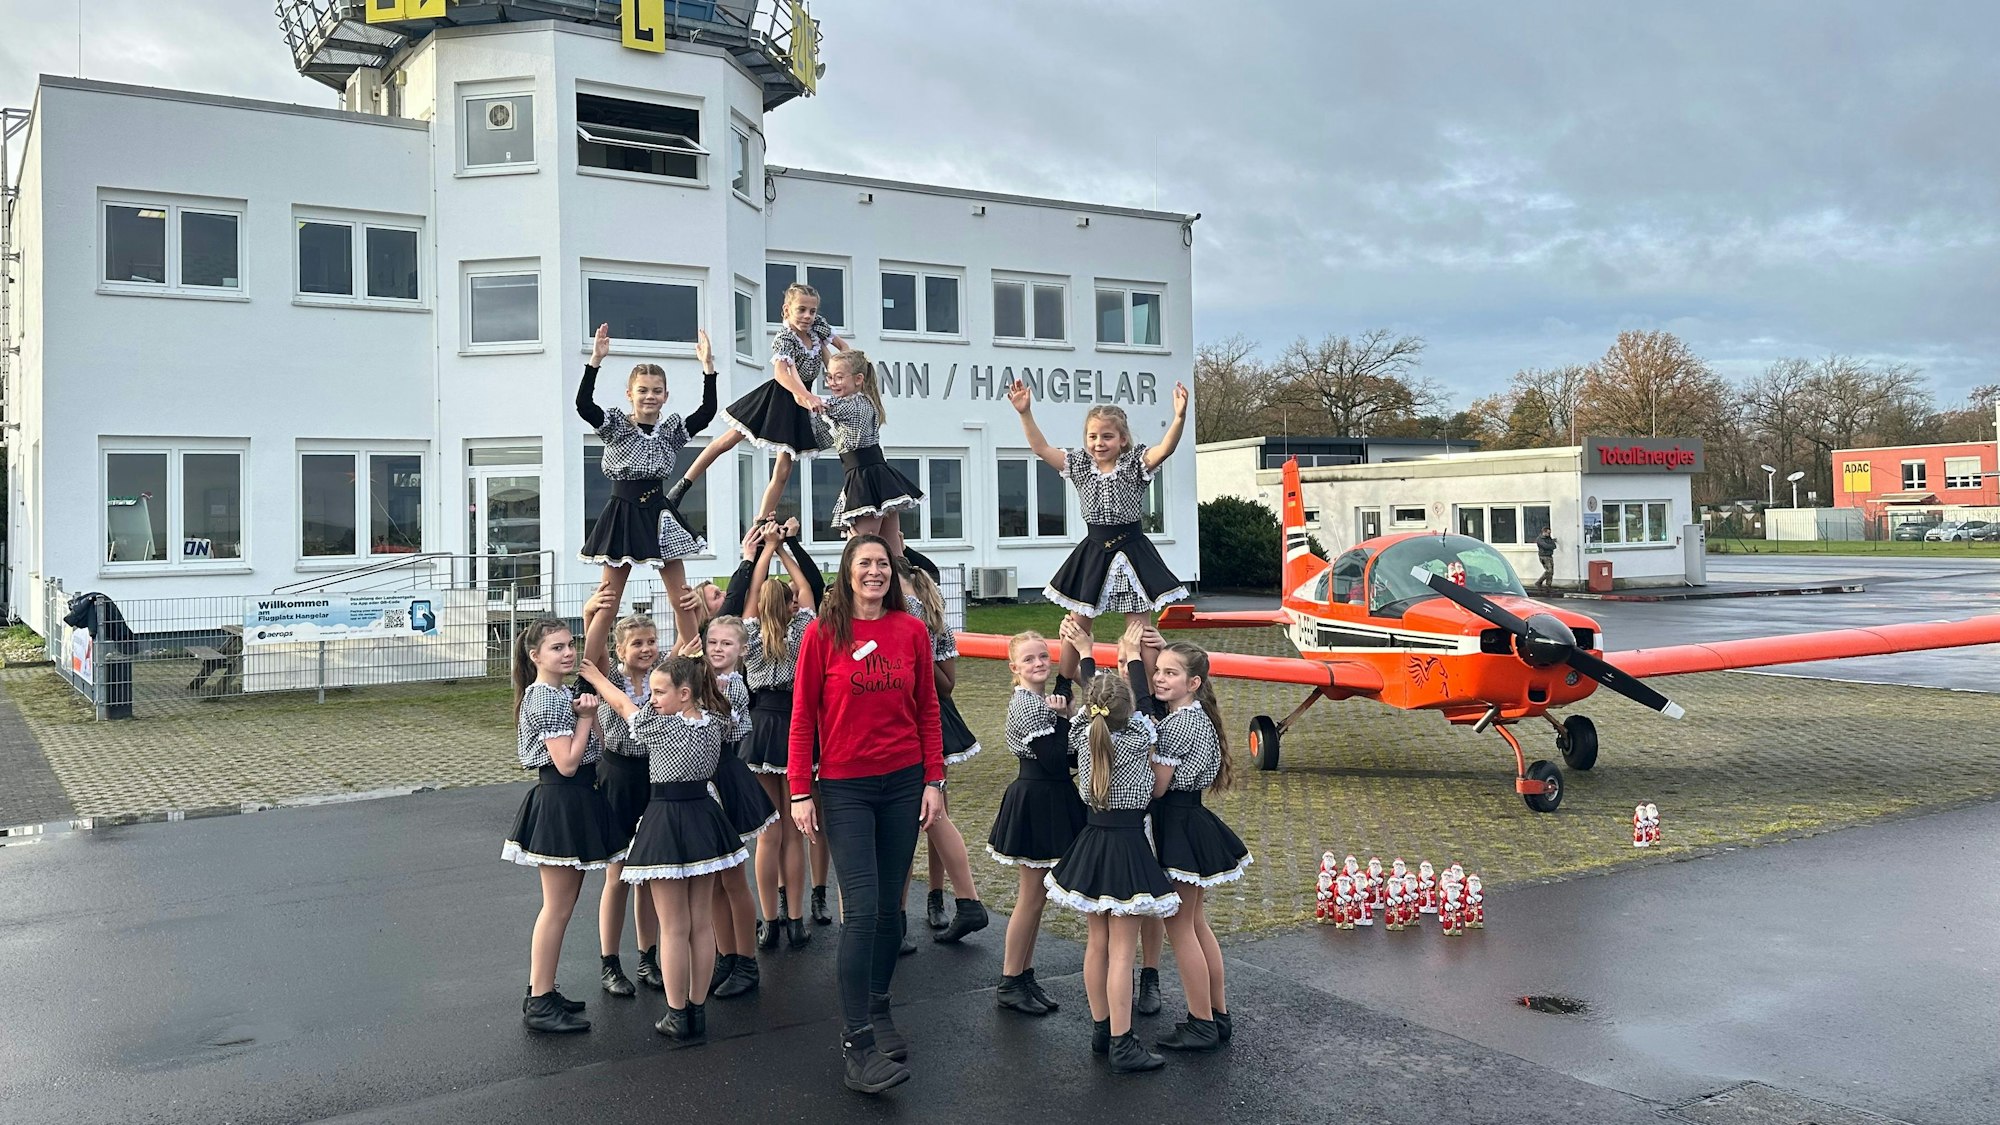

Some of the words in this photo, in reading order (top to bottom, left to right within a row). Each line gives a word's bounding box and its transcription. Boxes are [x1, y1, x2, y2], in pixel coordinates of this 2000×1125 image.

[970, 365, 1157, 405] HANGELAR
[1597, 445, 1696, 470] TotalEnergies
[1845, 463, 1869, 473] ADAC
[258, 600, 329, 610] Willkommen
[295, 612, 330, 620] Hangelar
[850, 671, 905, 696] Santa
